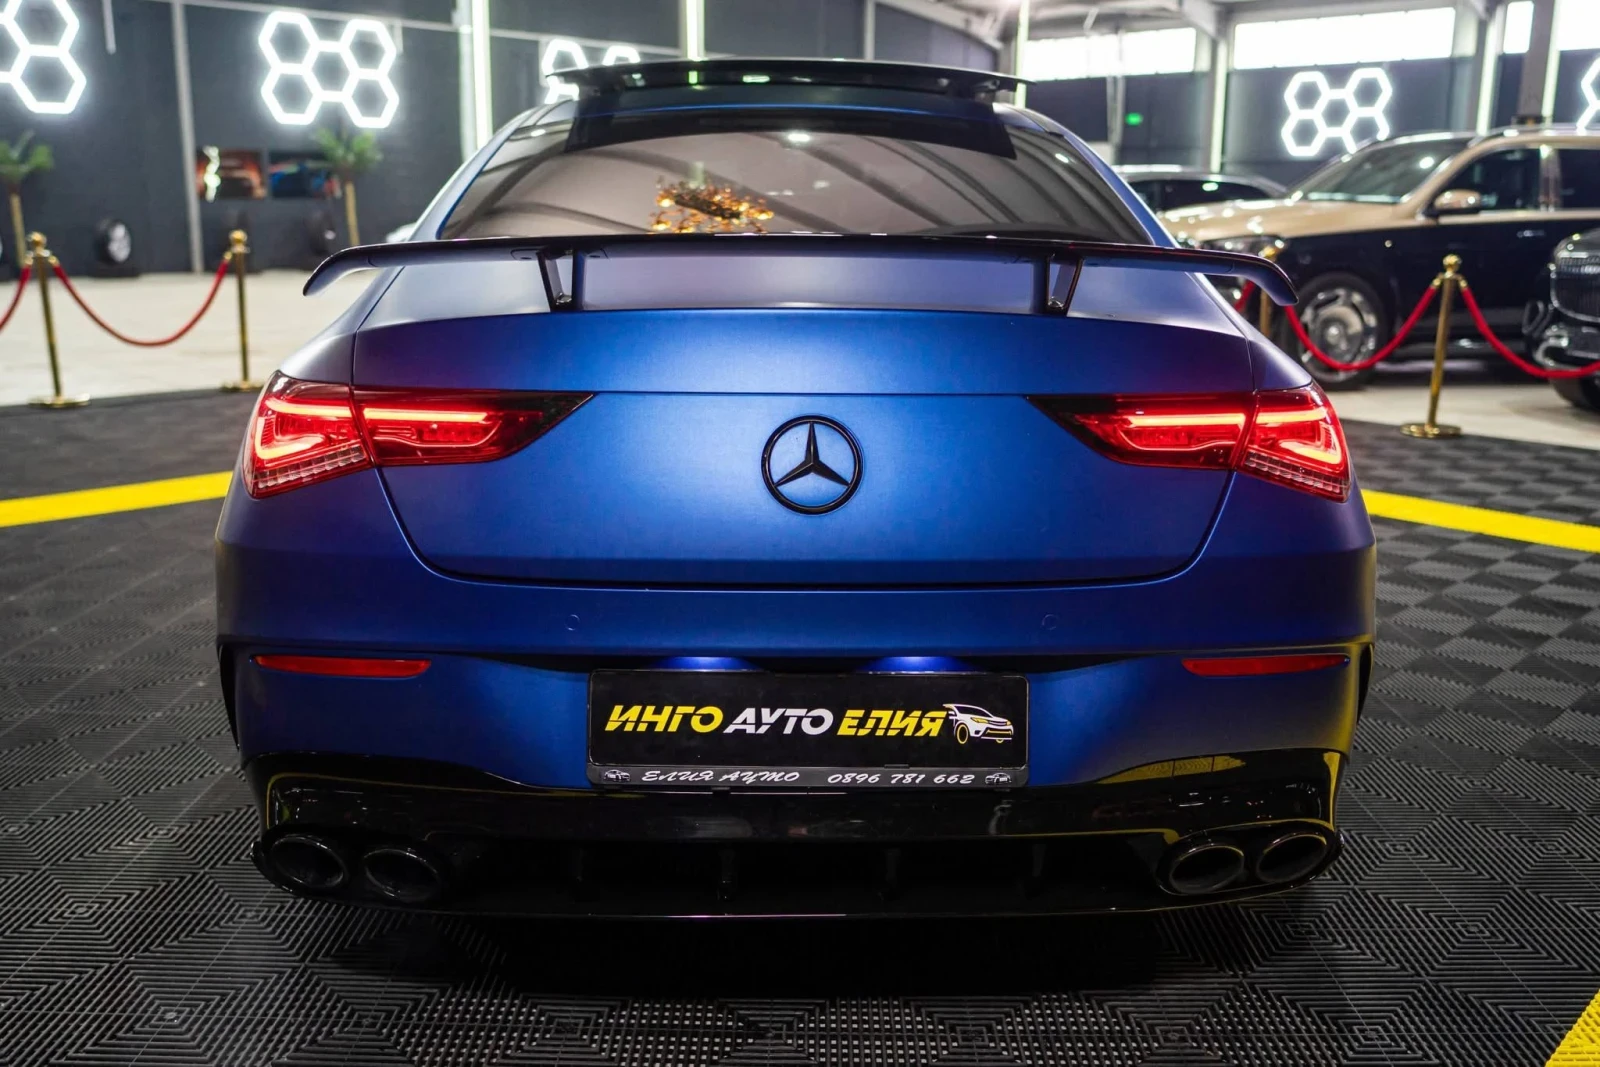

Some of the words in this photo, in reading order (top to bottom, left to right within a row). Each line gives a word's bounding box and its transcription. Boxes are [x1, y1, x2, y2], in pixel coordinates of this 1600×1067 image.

[604, 704, 724, 733] ИНГО
[724, 707, 834, 735] АУТО
[836, 709, 948, 737] ЕЛИЯ
[827, 772, 881, 784] 0896
[891, 773, 925, 785] 781
[933, 773, 976, 785] 662
